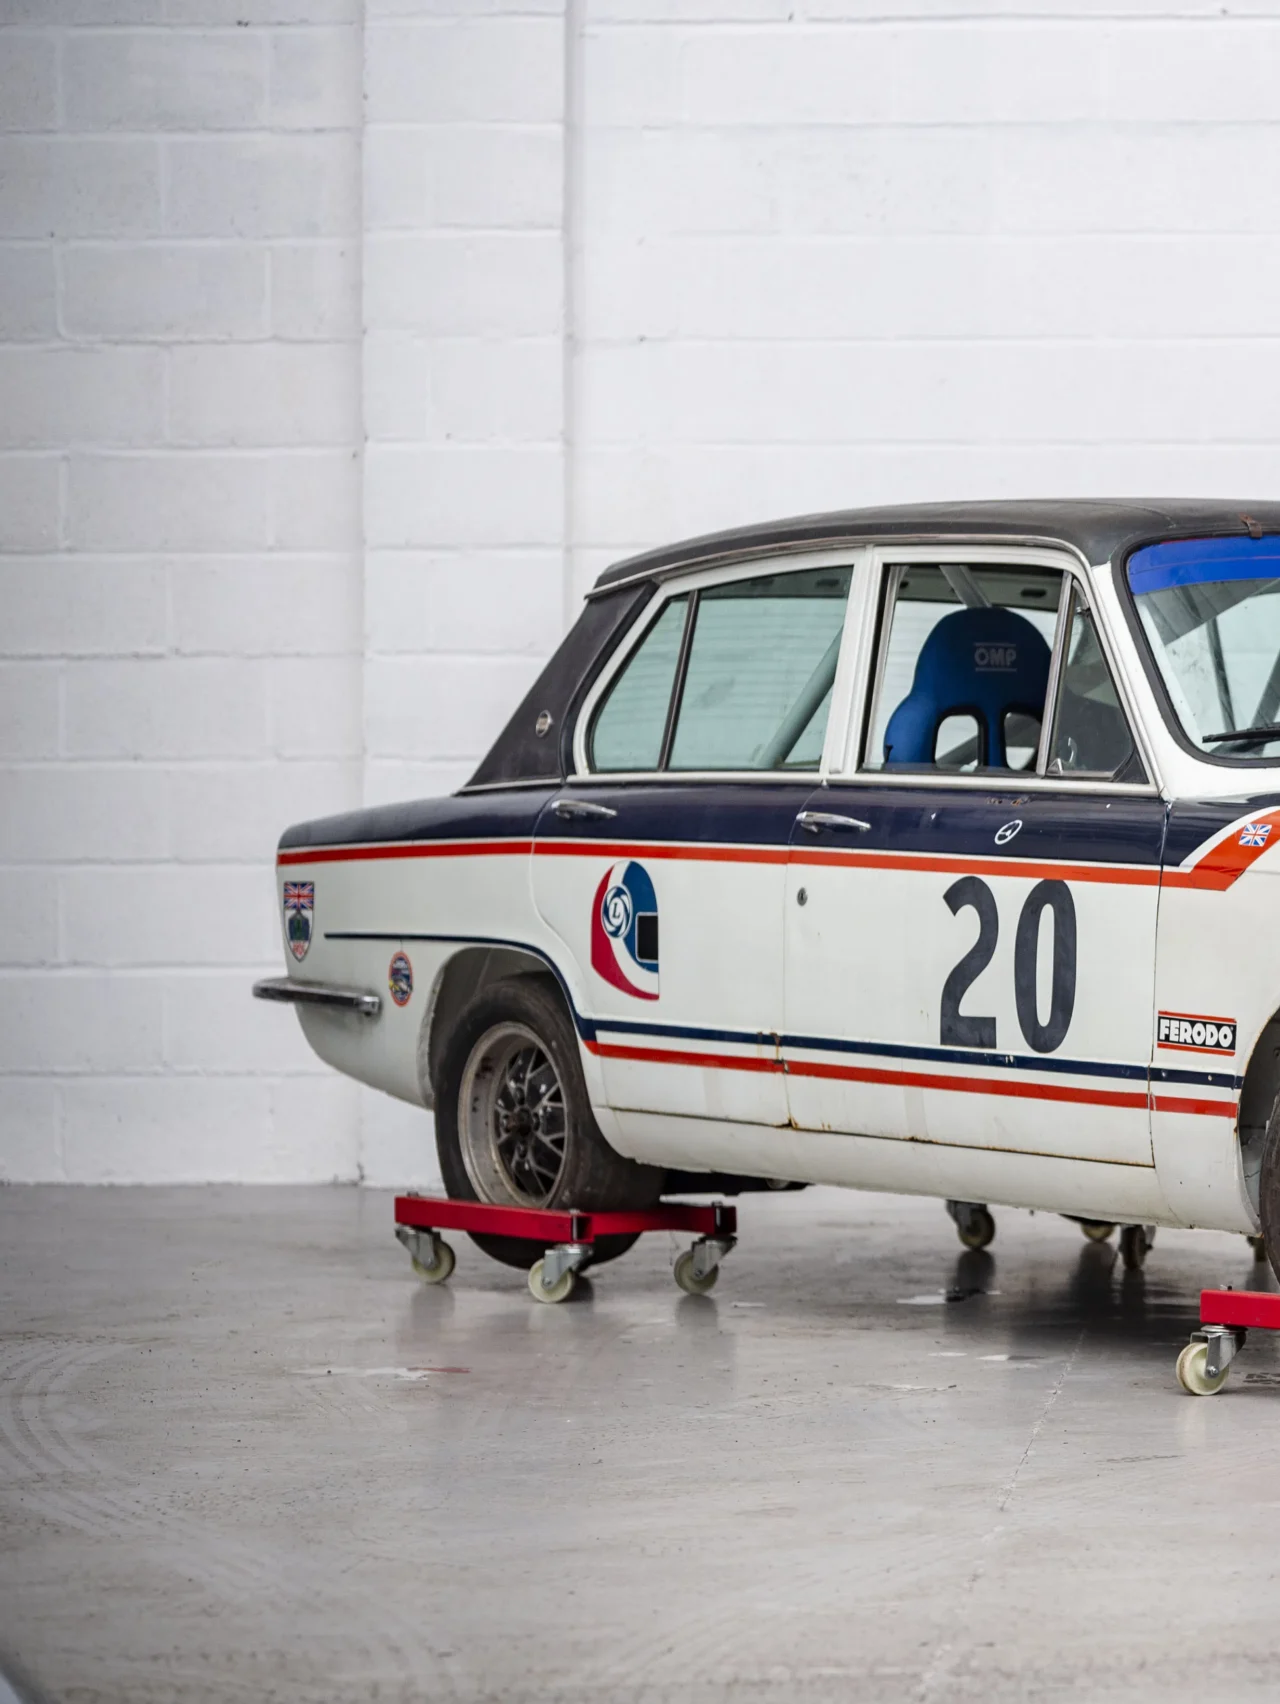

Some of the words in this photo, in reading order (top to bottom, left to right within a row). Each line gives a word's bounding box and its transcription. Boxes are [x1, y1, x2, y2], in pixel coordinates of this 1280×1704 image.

[974, 647, 1016, 666] OMP
[612, 902, 621, 919] L
[940, 875, 1077, 1054] 20
[1159, 1018, 1233, 1048] FERODO
